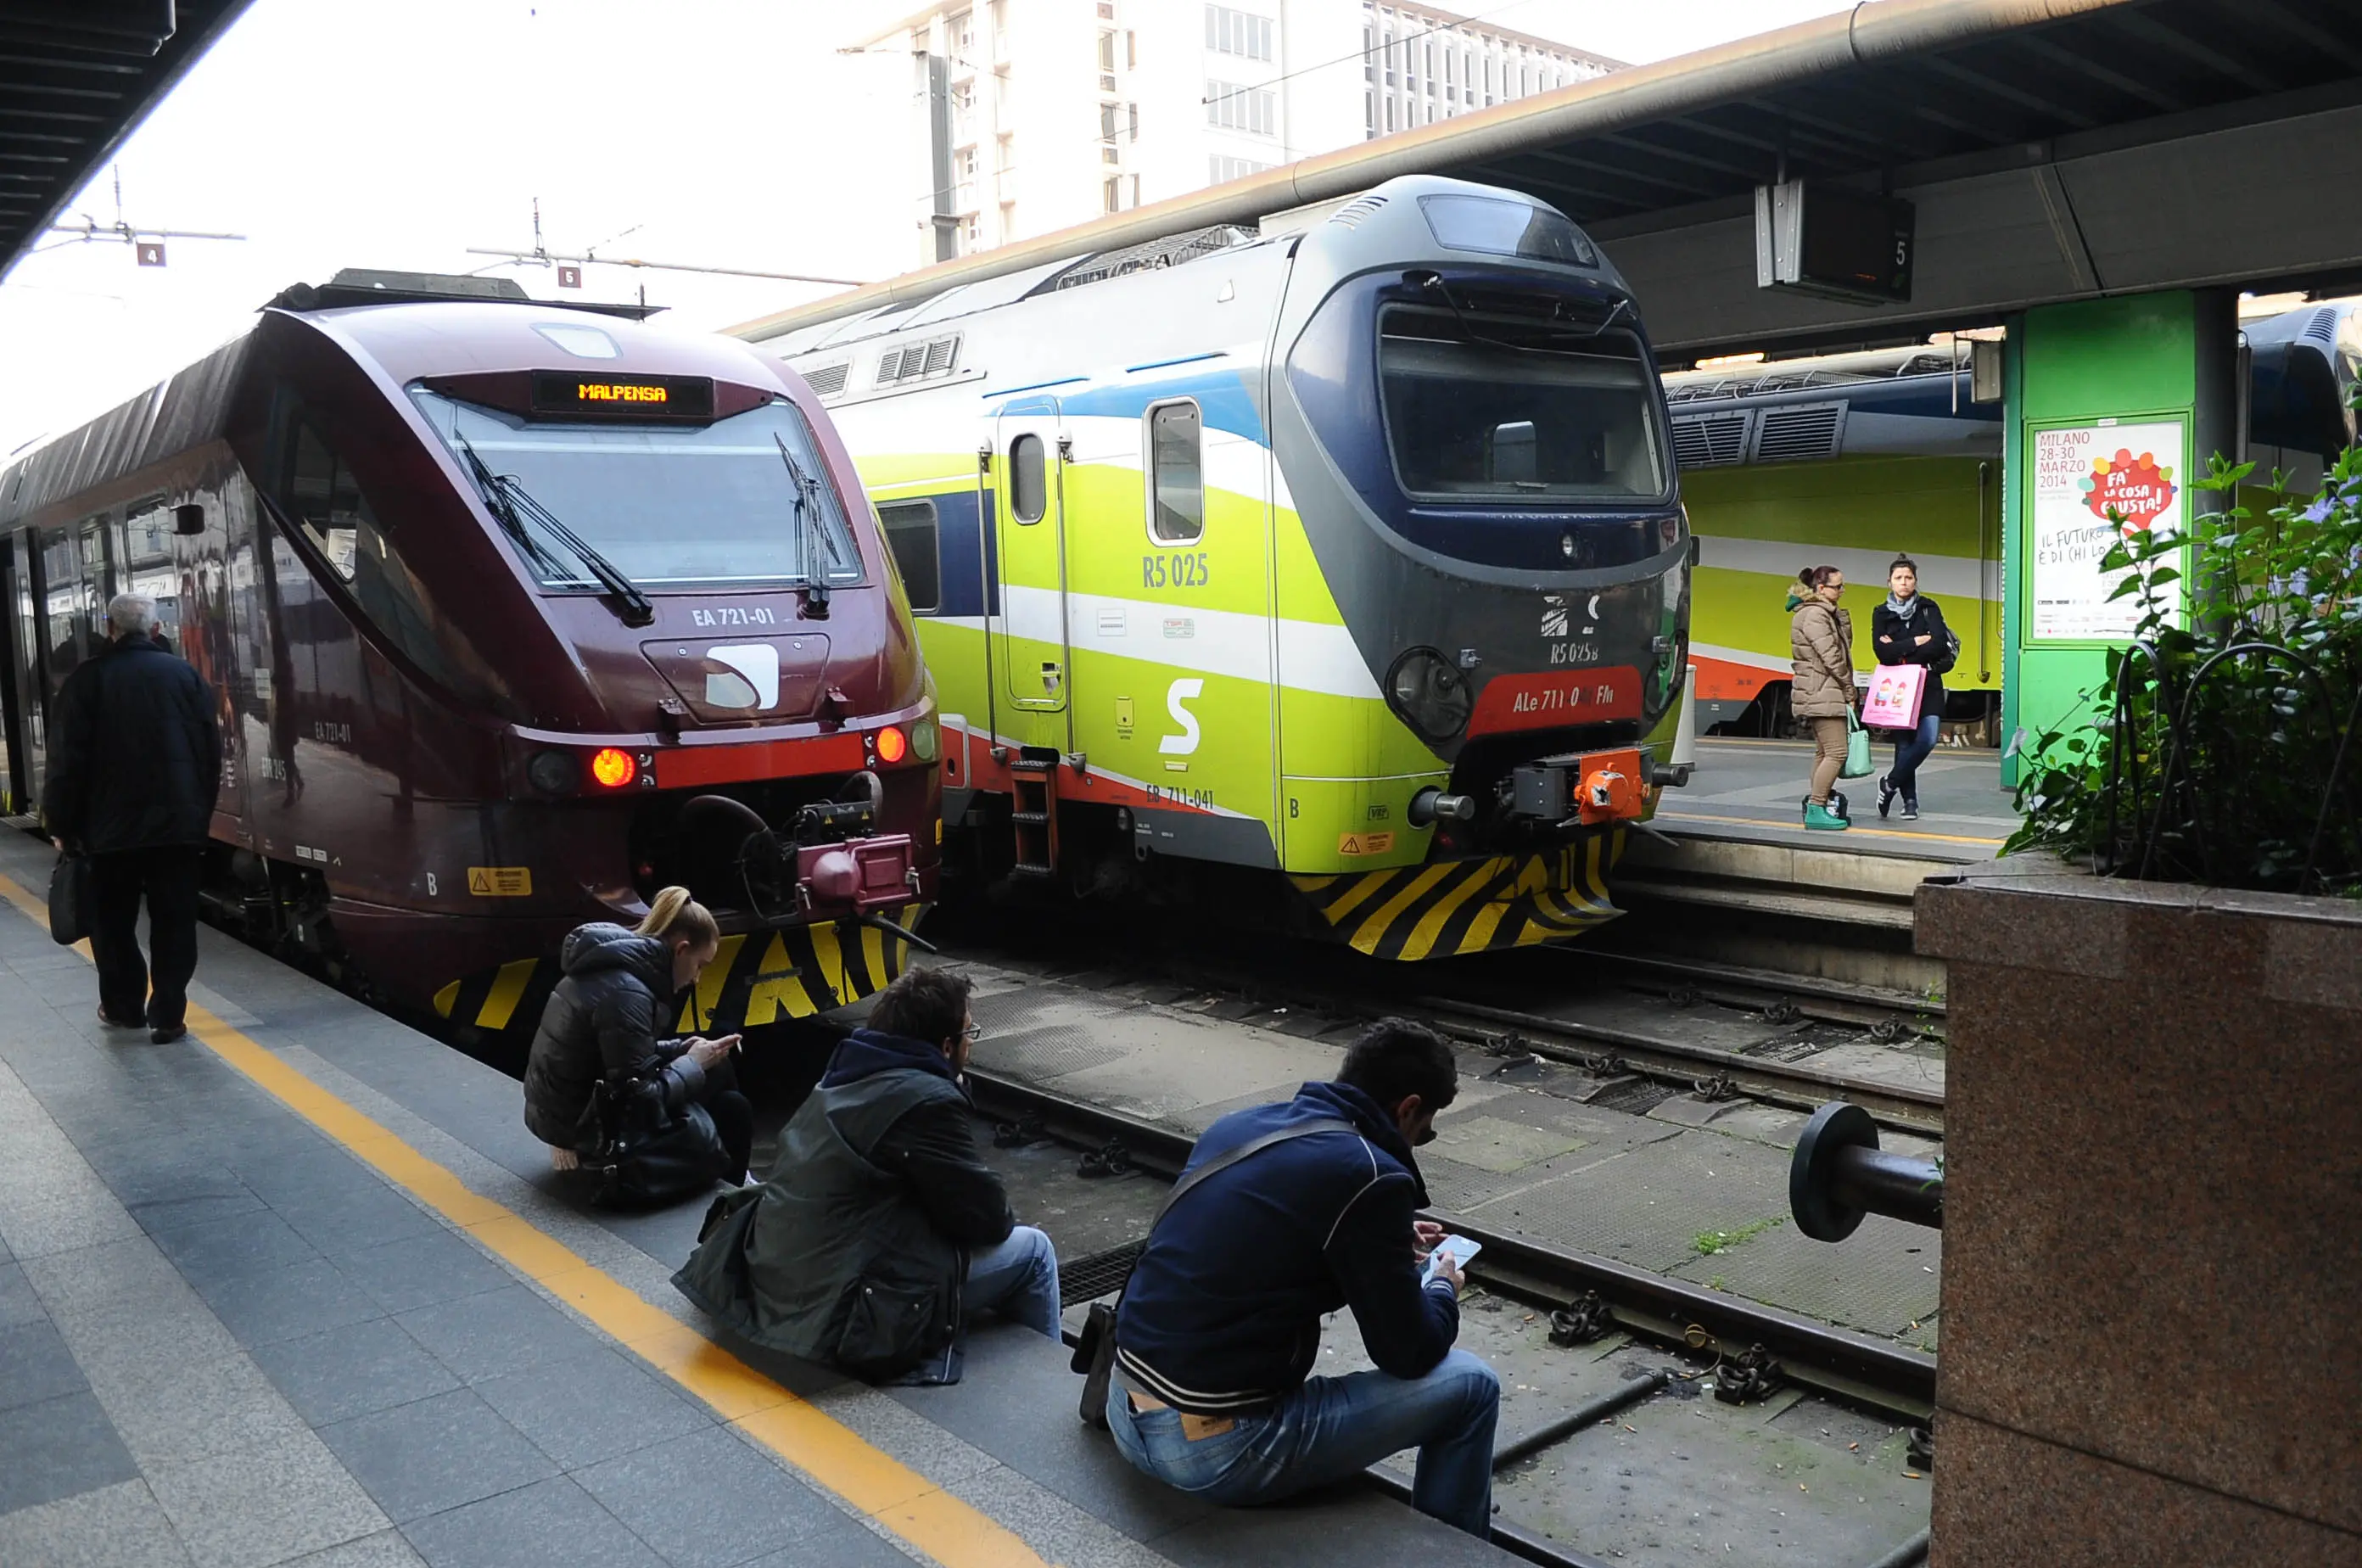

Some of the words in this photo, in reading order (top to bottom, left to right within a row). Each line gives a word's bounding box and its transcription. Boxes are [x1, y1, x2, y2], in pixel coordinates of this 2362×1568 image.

[148, 249, 158, 263] 4
[1896, 241, 1906, 265] 5
[566, 271, 574, 283] 5
[579, 384, 667, 402] MALPENSA
[2040, 431, 2091, 447] MILANO
[2040, 447, 2075, 461] 28-30
[2040, 460, 2085, 473] MARZO
[2040, 474, 2068, 488] 2014
[2100, 487, 2163, 515] GIUSTA!
[2103, 489, 2116, 497] LA
[2118, 484, 2150, 499] COSA
[2042, 535, 2053, 548] IL
[2057, 528, 2104, 548] FUTURO
[2051, 552, 2063, 563] DI
[2069, 546, 2086, 564] CHI
[2092, 546, 2106, 557] LO
[1172, 552, 1208, 587] 025
[691, 608, 717, 627] EA
[718, 607, 775, 626] 721-01
[1541, 689, 1564, 710] 711
[325, 721, 352, 742] 721-01
[1146, 784, 1160, 803] EB
[1167, 787, 1214, 809] 711-041
[1290, 798, 1300, 819] B
[427, 872, 438, 896] B
